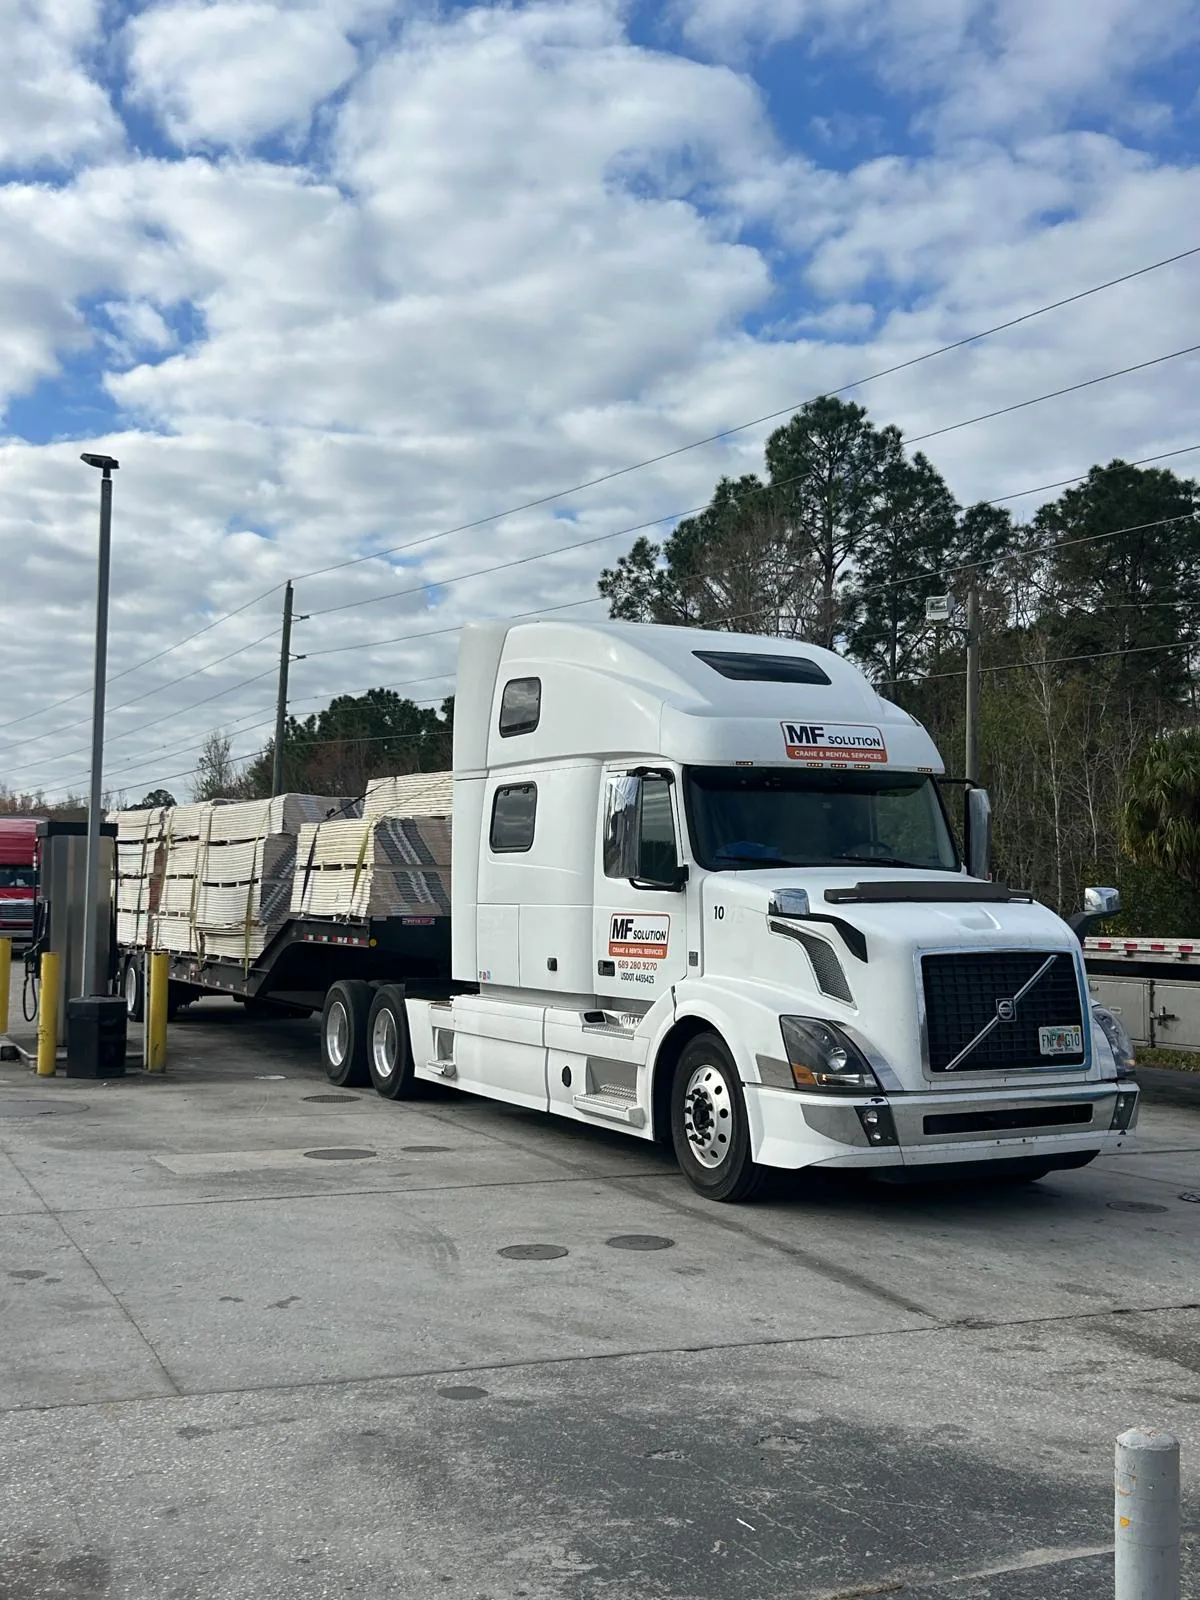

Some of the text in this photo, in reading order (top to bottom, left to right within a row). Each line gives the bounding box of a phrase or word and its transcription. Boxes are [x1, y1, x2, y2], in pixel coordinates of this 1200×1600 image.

[785, 725, 880, 747] MF SOLUTION
[851, 752, 882, 760] SERVICES
[714, 905, 724, 920] 10
[612, 918, 667, 941] MF SOLUTION
[618, 960, 658, 971] 689 280 9270
